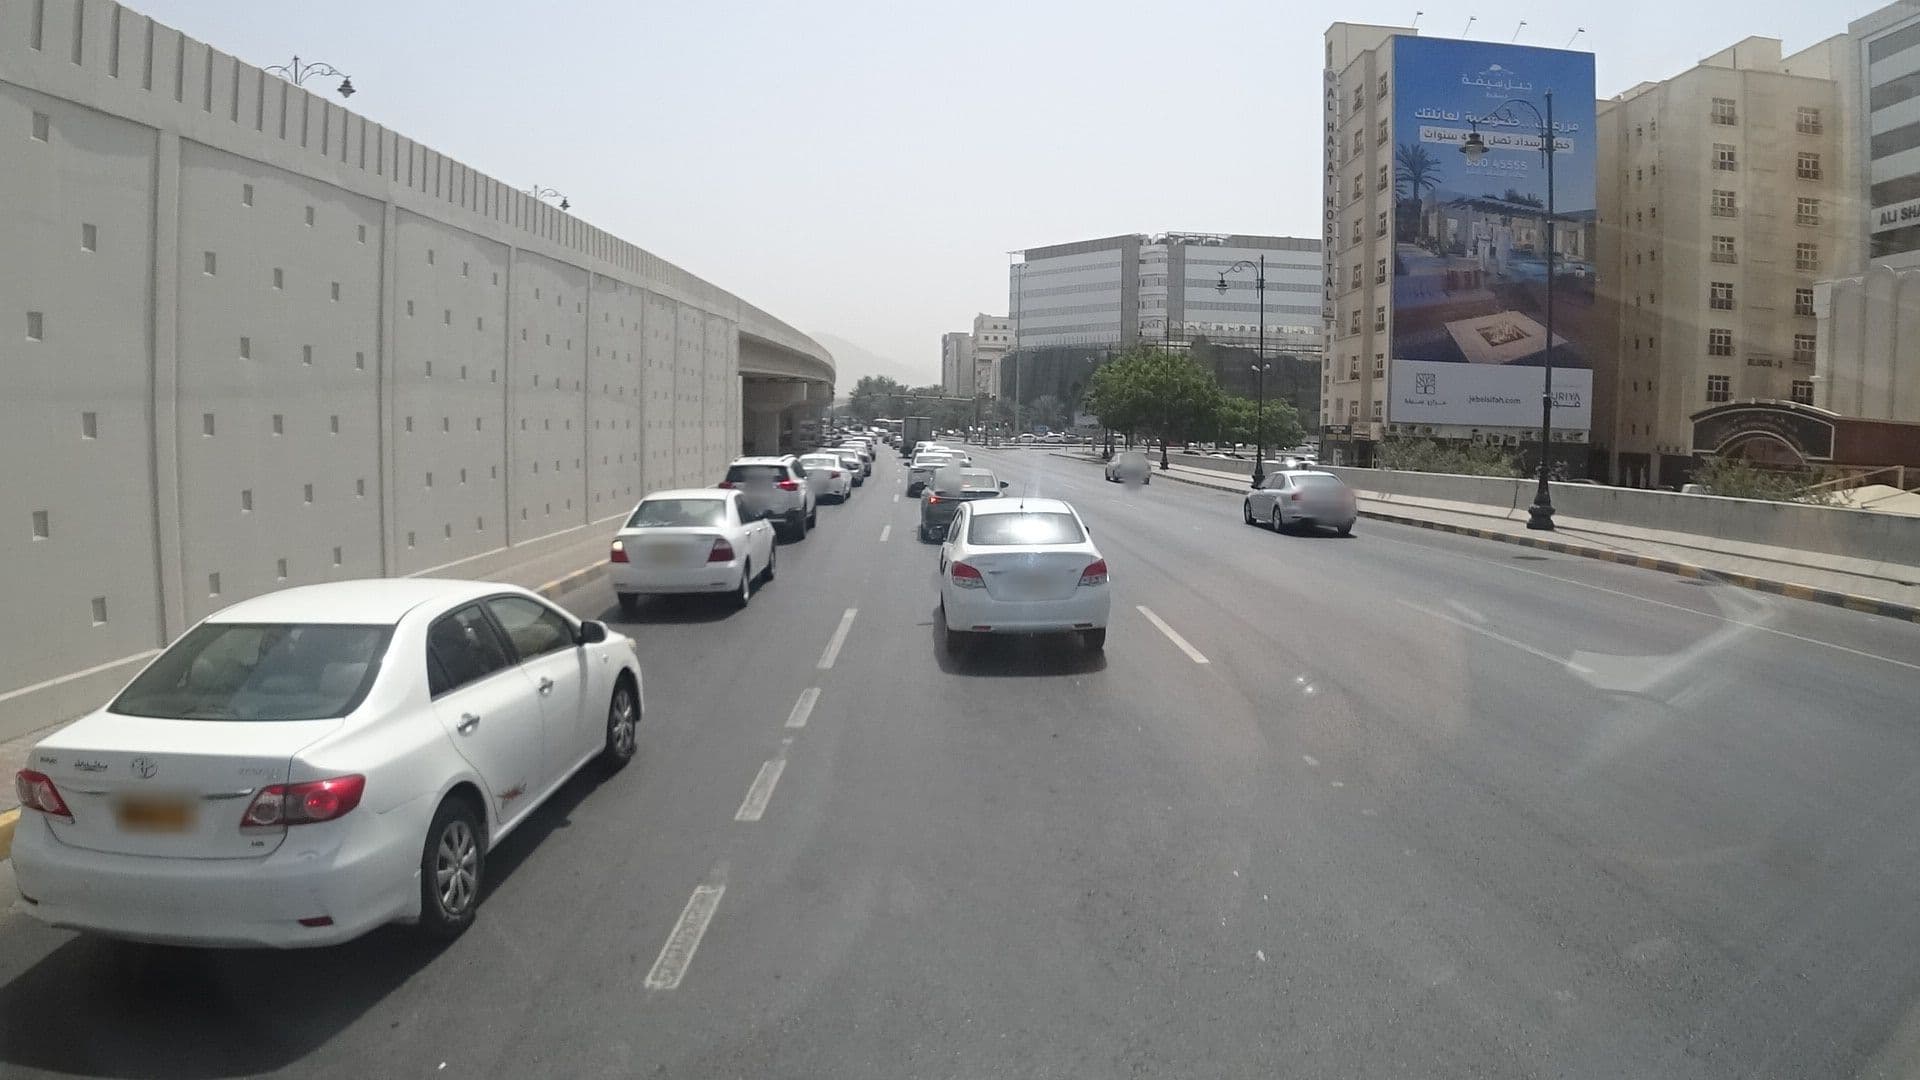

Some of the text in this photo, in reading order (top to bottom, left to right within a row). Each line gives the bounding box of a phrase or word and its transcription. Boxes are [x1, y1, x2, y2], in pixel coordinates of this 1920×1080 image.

[1325, 87, 1335, 301] AL HAYAT HOSPITAL
[1880, 209, 1897, 226] ALI
[1550, 391, 1581, 401] URIYA
